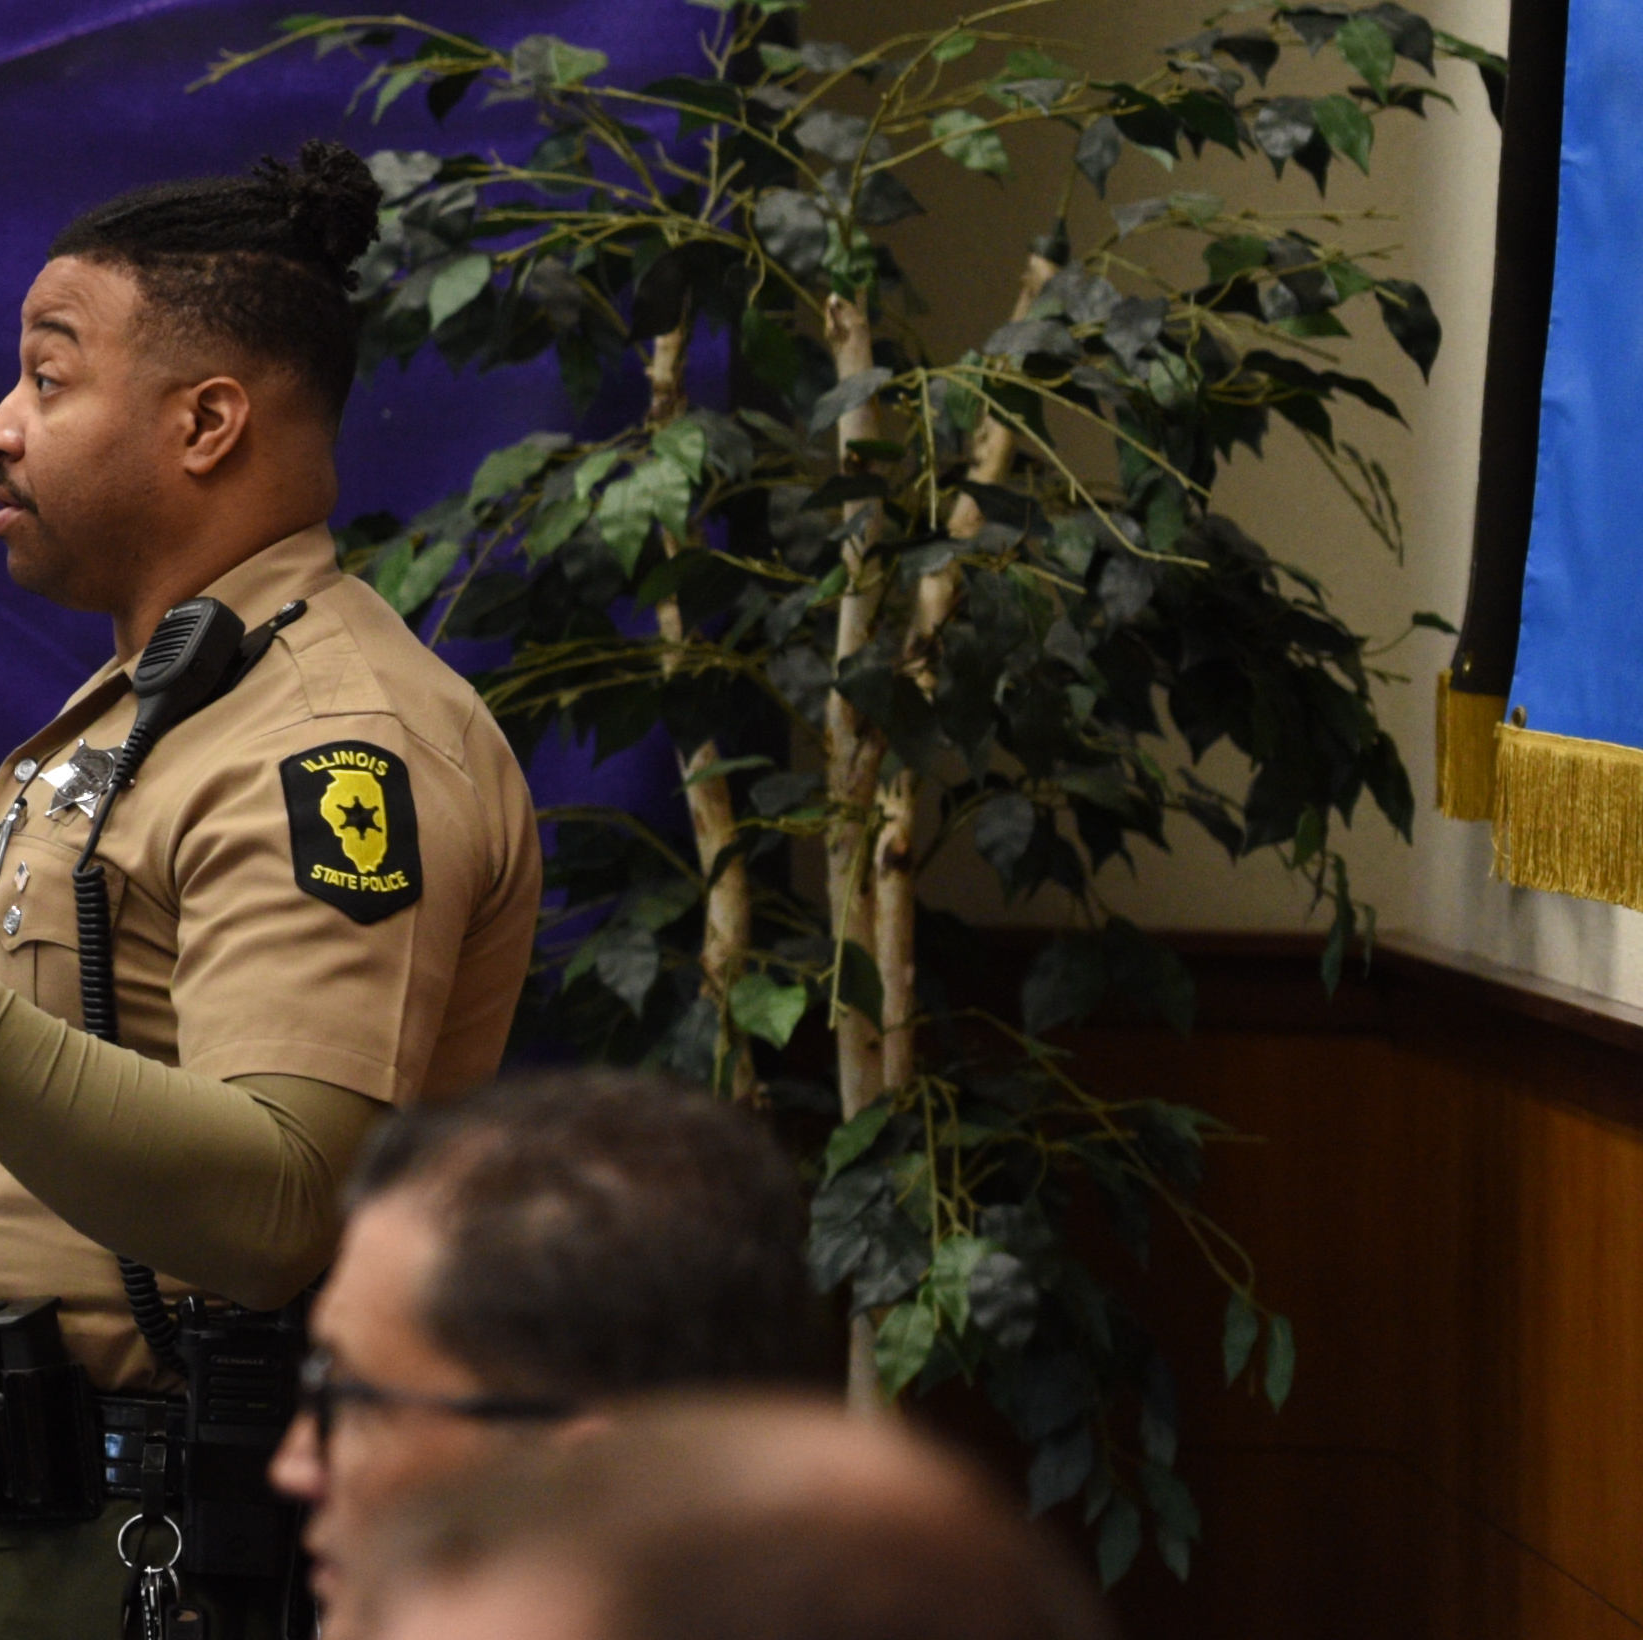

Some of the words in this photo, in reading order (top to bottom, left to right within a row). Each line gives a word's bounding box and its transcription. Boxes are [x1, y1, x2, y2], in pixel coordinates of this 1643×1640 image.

[300, 750, 389, 777] ILLINOIS
[310, 863, 358, 891] STATE
[360, 870, 410, 893] POLICE
